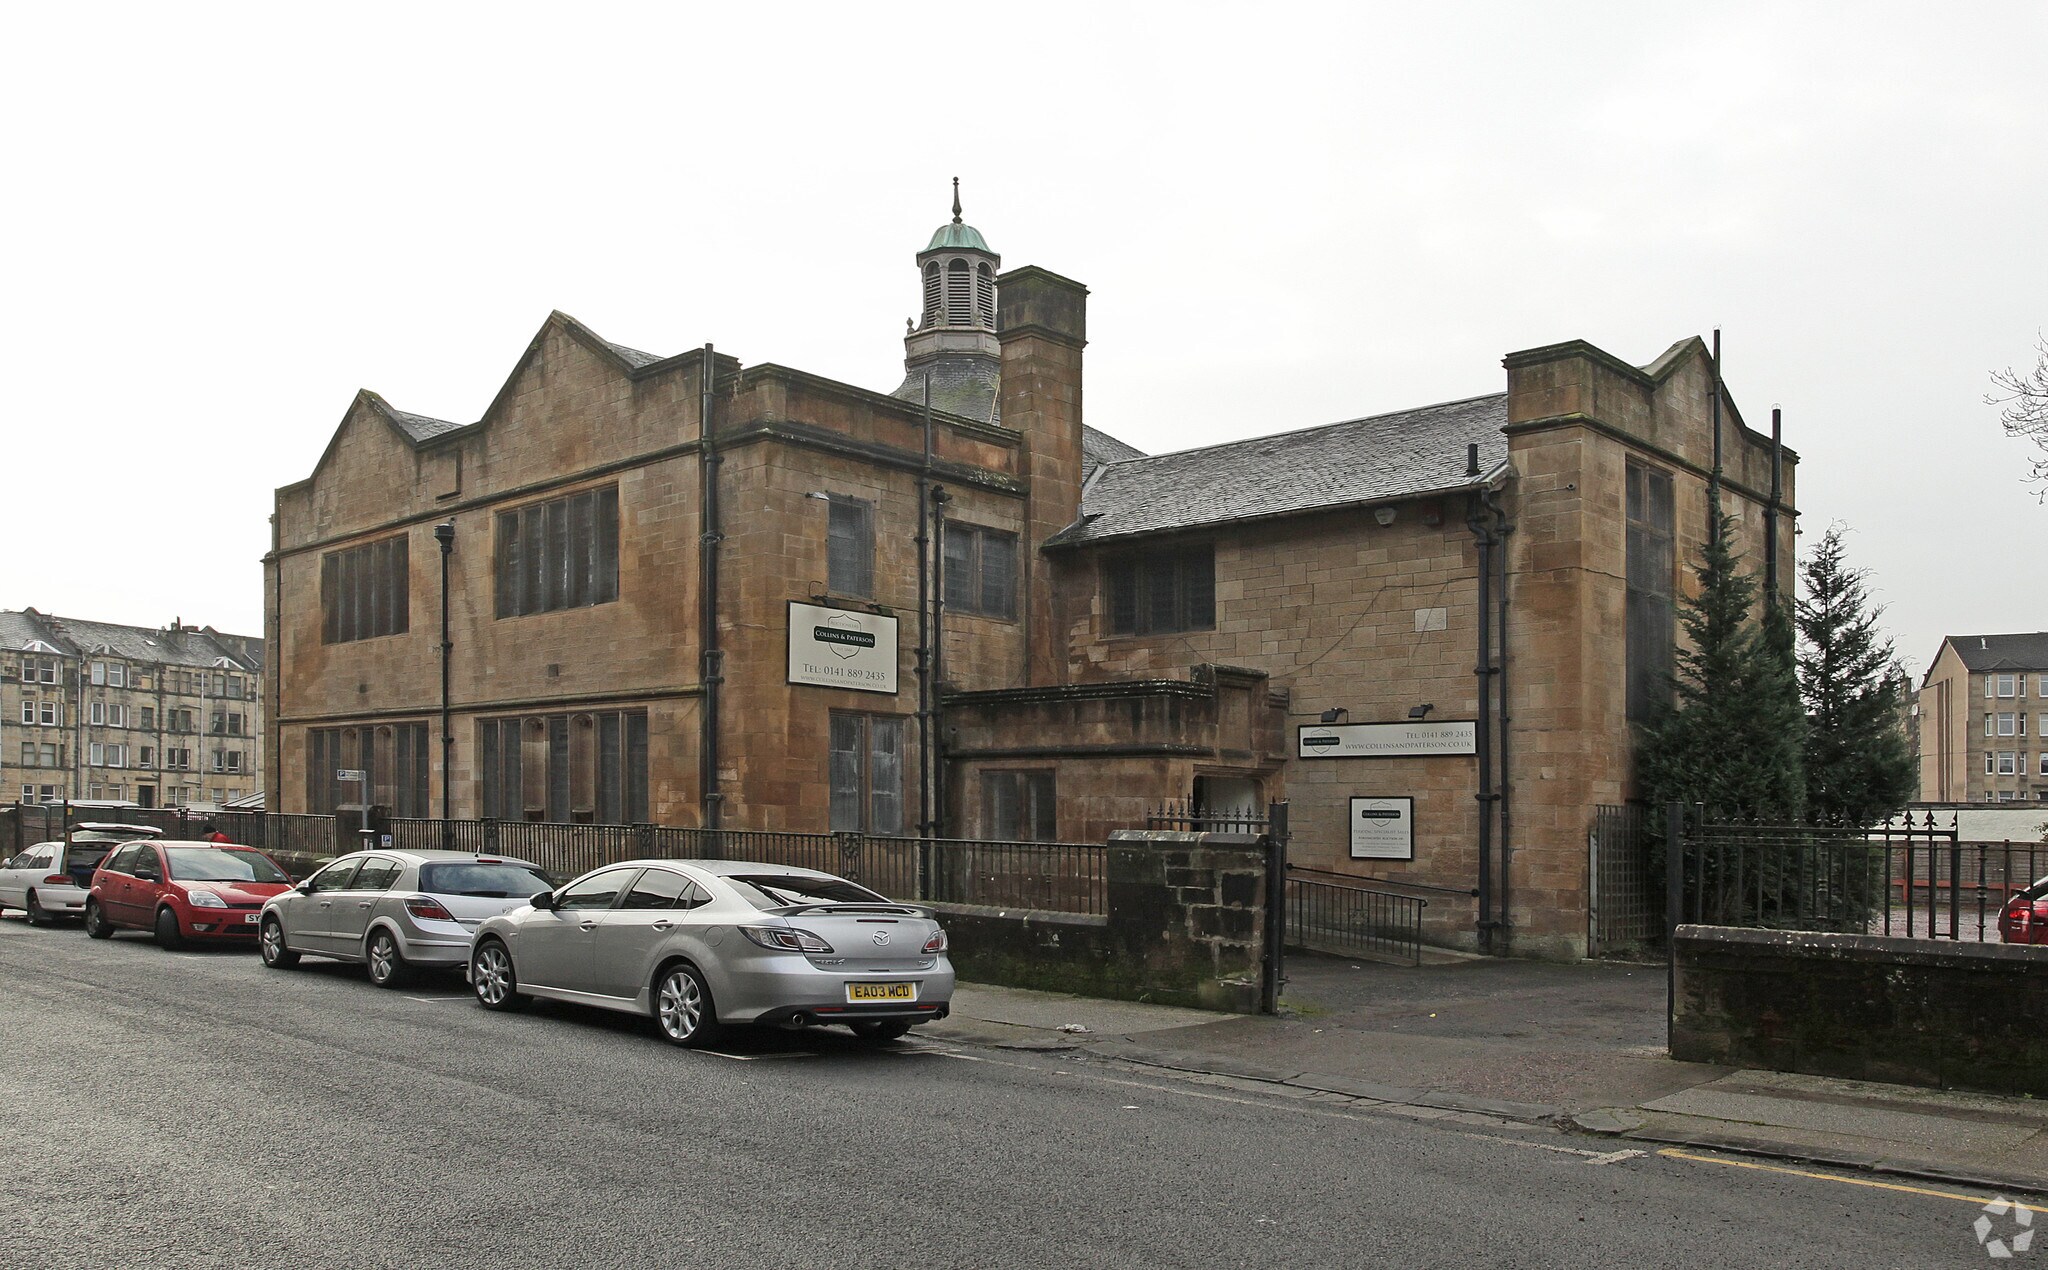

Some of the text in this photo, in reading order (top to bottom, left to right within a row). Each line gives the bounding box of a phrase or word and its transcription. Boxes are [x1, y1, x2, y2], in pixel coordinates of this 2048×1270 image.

[815, 630, 840, 639] COLLINS
[846, 635, 874, 643] PATERSON
[803, 664, 885, 681] TEL: 0141 889 2435
[1421, 731, 1438, 739] 0141
[1440, 730, 1454, 738] 889
[1455, 730, 1473, 738] 2435
[1345, 741, 1472, 750] WWW.COLLINSANDPATERSON.CO.UK
[855, 986, 886, 997] EA03
